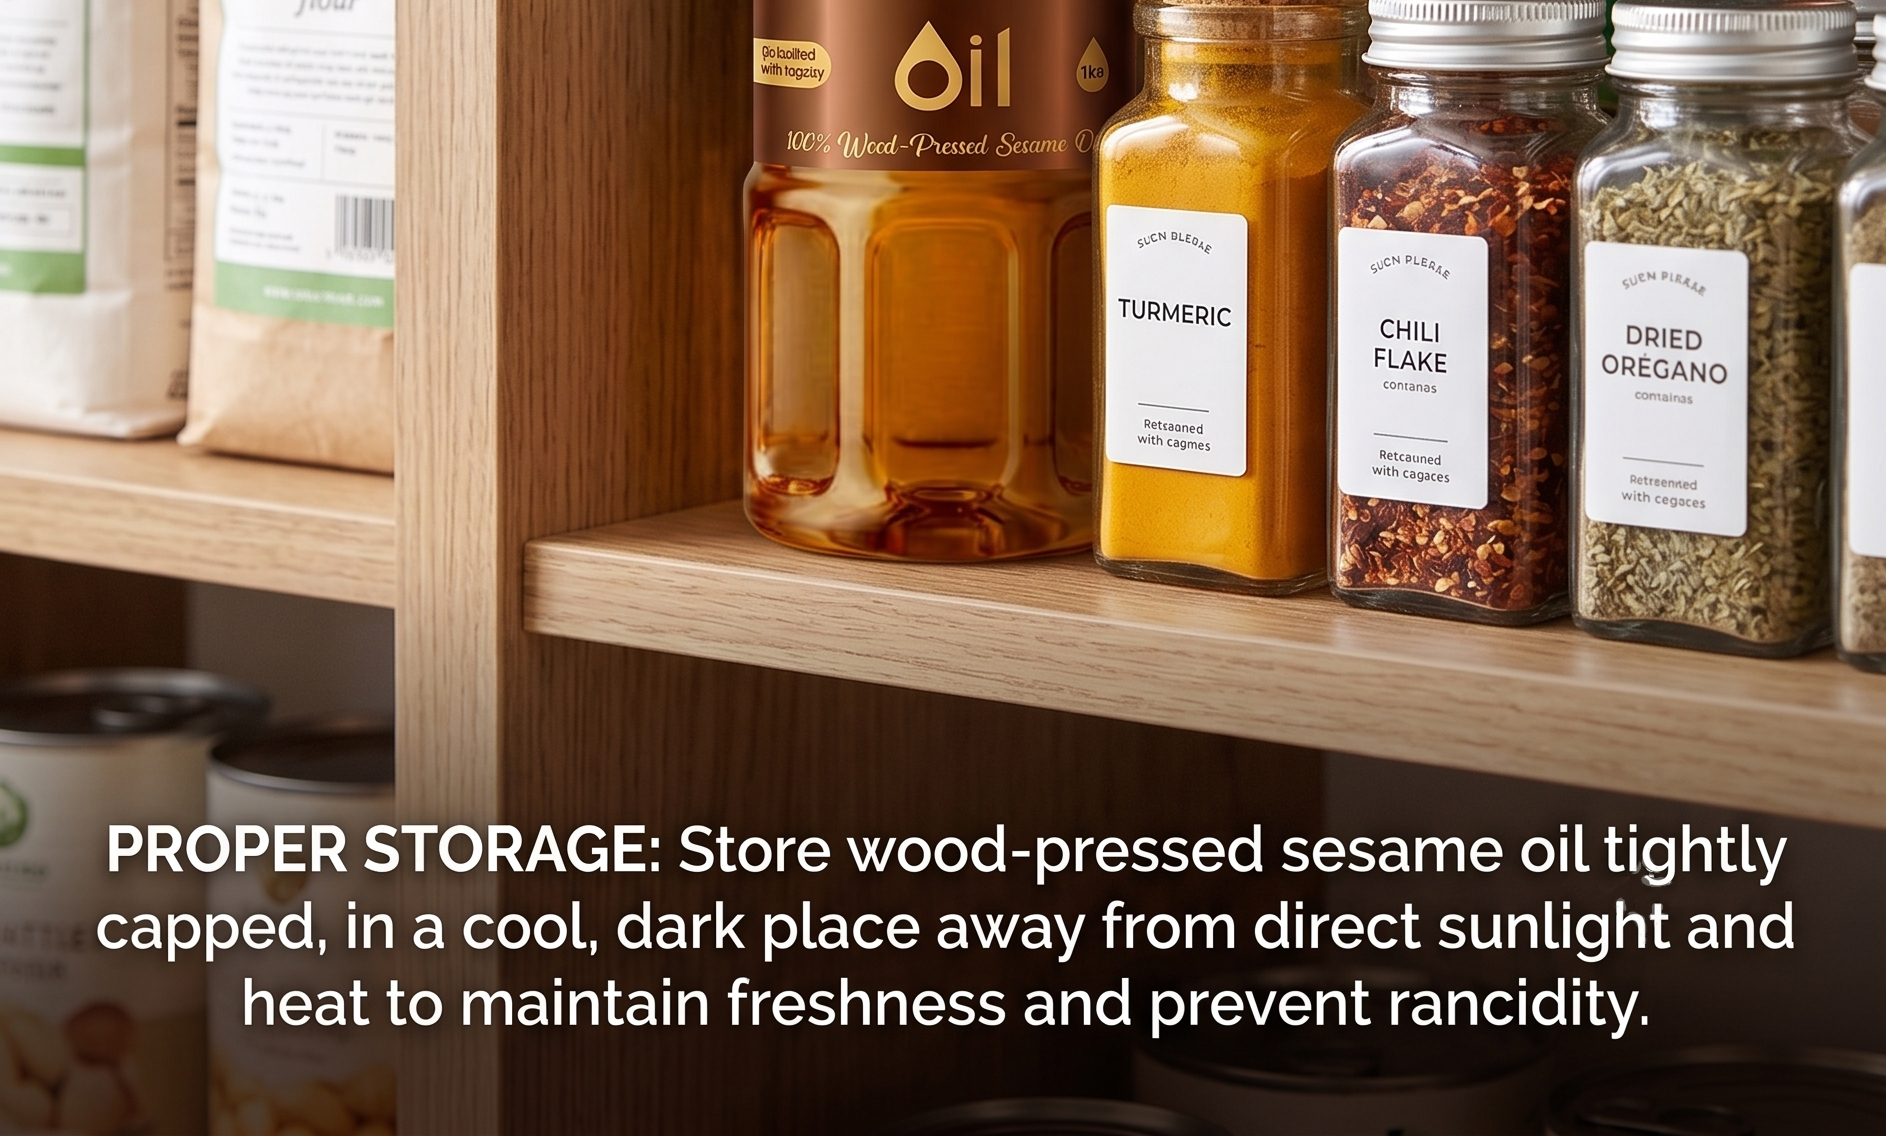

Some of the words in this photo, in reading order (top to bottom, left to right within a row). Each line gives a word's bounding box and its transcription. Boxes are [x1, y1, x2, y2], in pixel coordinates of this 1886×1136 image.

[761, 62, 783, 77] with
[894, 20, 1010, 112] Oil
[787, 130, 831, 154] 100%
[995, 132, 1068, 157] Sesame
[1118, 298, 1232, 327] TURMERIC
[1380, 318, 1439, 343] CHILI
[1626, 324, 1703, 351] DRIED
[1374, 347, 1447, 374] FLAKE
[1137, 433, 1163, 446] with
[1371, 464, 1399, 478] with
[1621, 490, 1651, 503] with
